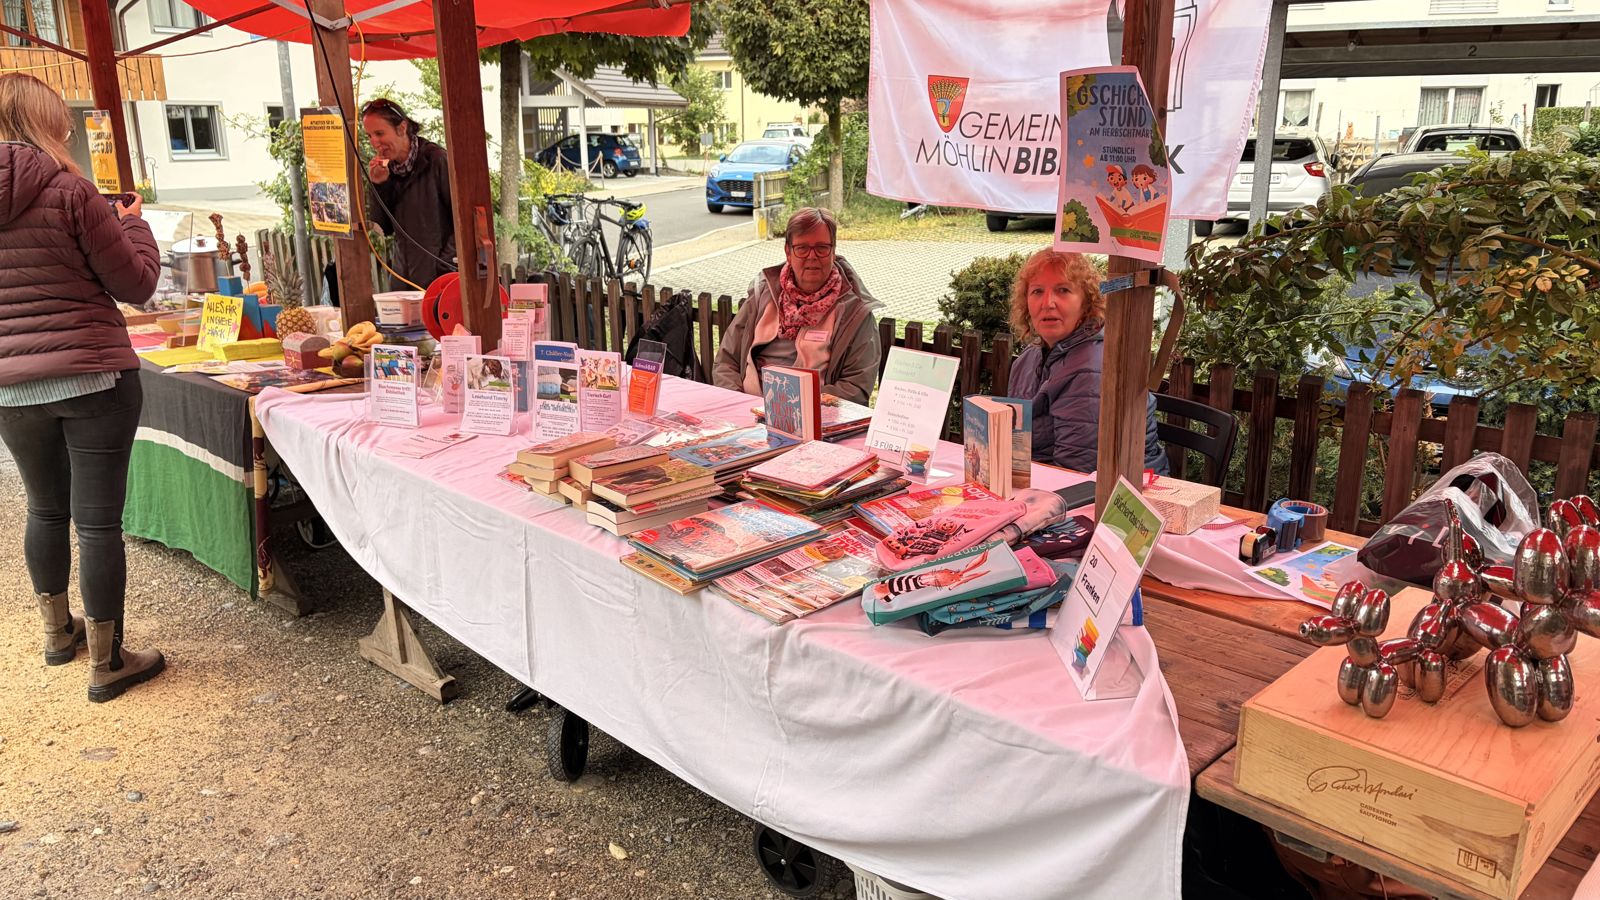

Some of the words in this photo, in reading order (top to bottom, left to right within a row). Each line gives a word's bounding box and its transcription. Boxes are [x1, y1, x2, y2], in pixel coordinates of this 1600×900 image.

[1467, 45, 1478, 57] 2
[1098, 106, 1147, 128] STUND
[1089, 127, 1101, 137] AM
[1102, 145, 1135, 155] STÜNDLICH
[873, 440, 879, 448] 3
[1113, 493, 1150, 538] Büchertaschen
[1089, 554, 1098, 569] 20
[1081, 573, 1101, 605] Franken
[1360, 802, 1394, 819] CABERNET
[1360, 808, 1398, 828] SAUVIGNON
